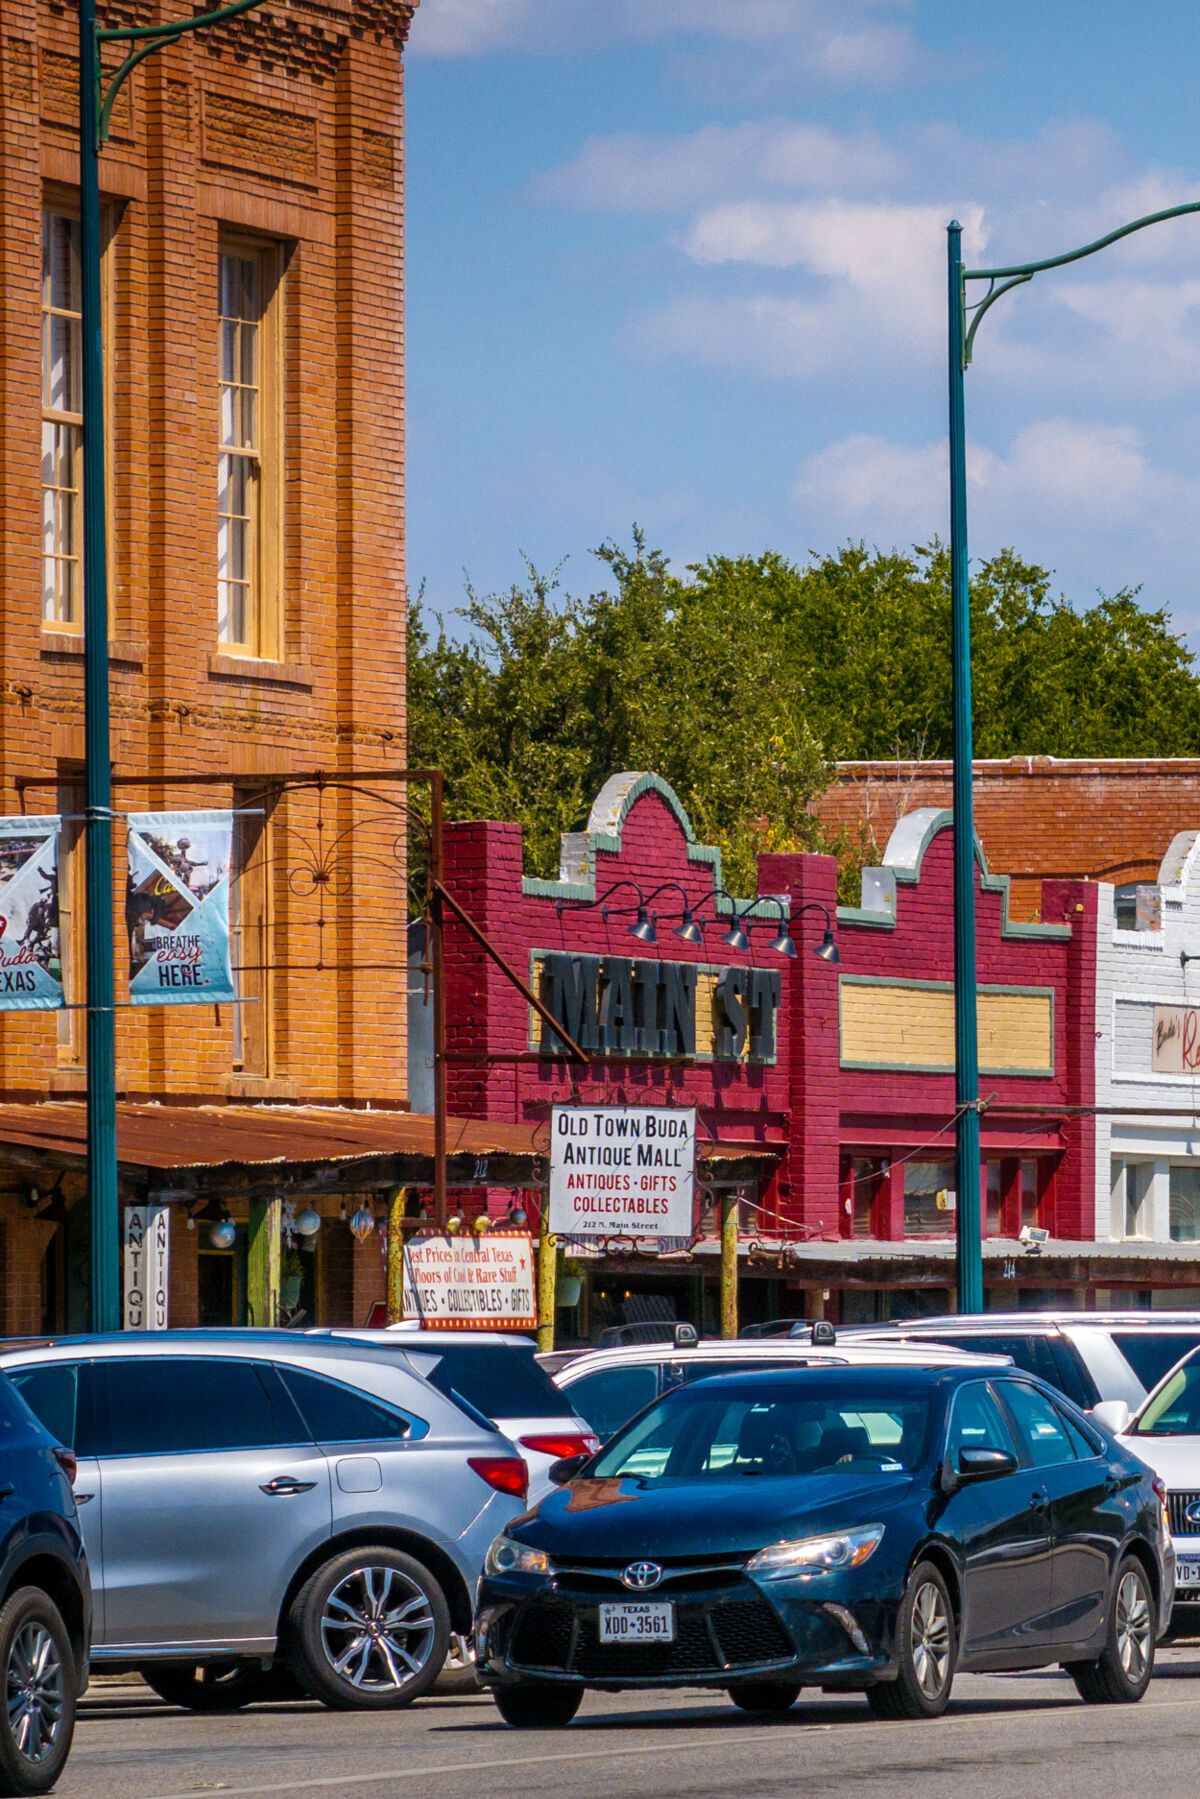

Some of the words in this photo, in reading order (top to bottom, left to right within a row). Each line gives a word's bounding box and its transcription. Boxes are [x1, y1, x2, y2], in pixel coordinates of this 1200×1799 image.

[157, 935, 200, 950] BREATHE
[157, 946, 203, 965] easy
[543, 954, 698, 1054] MAIN
[713, 967, 782, 1062] ST
[558, 1113, 588, 1136] OLD
[594, 1114, 640, 1138] TOWN
[645, 1115, 688, 1139] BUDA
[563, 1143, 632, 1166] ANTIQUE
[637, 1144, 682, 1167] MALL
[567, 1174, 631, 1190] ANTIQUES
[640, 1176, 677, 1191] GIFTS
[573, 1197, 669, 1214] COLLECTABLES
[608, 1221, 628, 1229] Main
[631, 1222, 659, 1230] Street
[426, 1247, 452, 1263] Prices
[462, 1247, 490, 1262] Central
[491, 1247, 514, 1262] Texas
[128, 1213, 143, 1327] ANTIQU
[156, 1213, 166, 1328] ANTIQU
[444, 1267, 452, 1283] of
[476, 1267, 497, 1283] Rare
[448, 1288, 503, 1312] COLLECTIBLES
[511, 1288, 530, 1312] GIFTS
[622, 1605, 650, 1614] TEXAS
